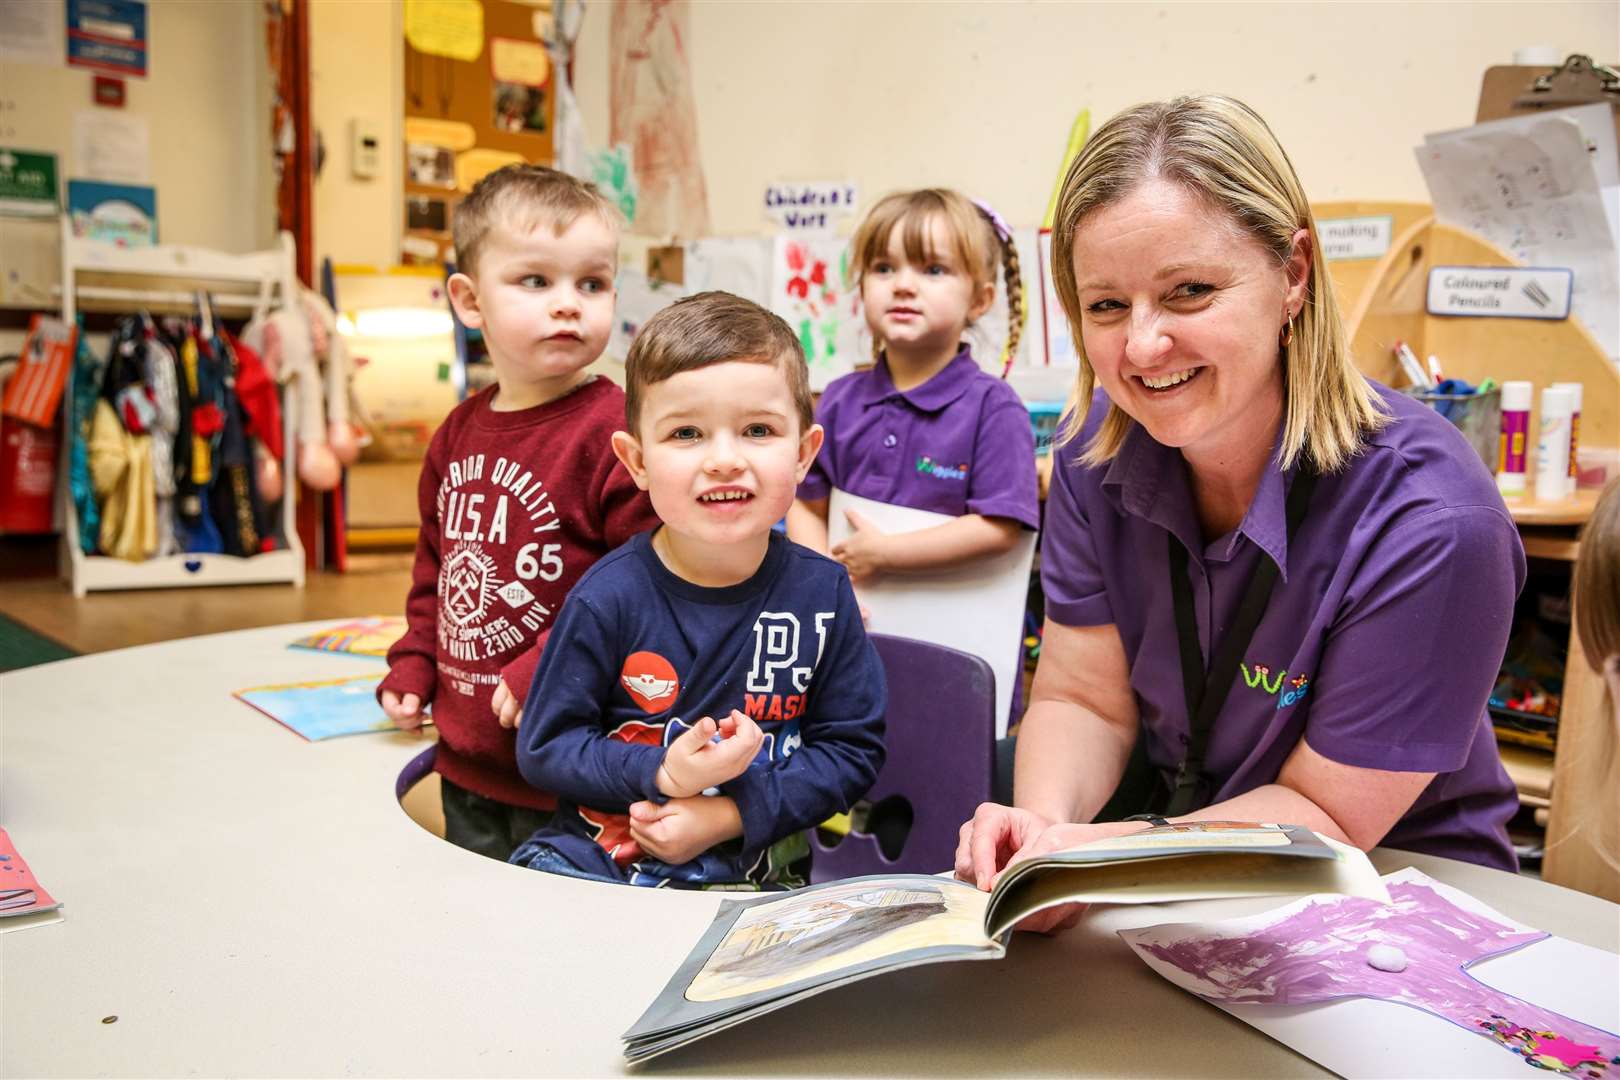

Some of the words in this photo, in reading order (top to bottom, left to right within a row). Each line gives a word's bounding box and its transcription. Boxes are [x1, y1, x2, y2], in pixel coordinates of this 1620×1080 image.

[1443, 276, 1511, 291] Coloured
[1448, 294, 1501, 308] Pencils
[491, 456, 560, 533] QUALITY
[515, 542, 564, 582] 65
[458, 616, 510, 642] SUPPLIERS
[483, 625, 525, 657] 23RD
